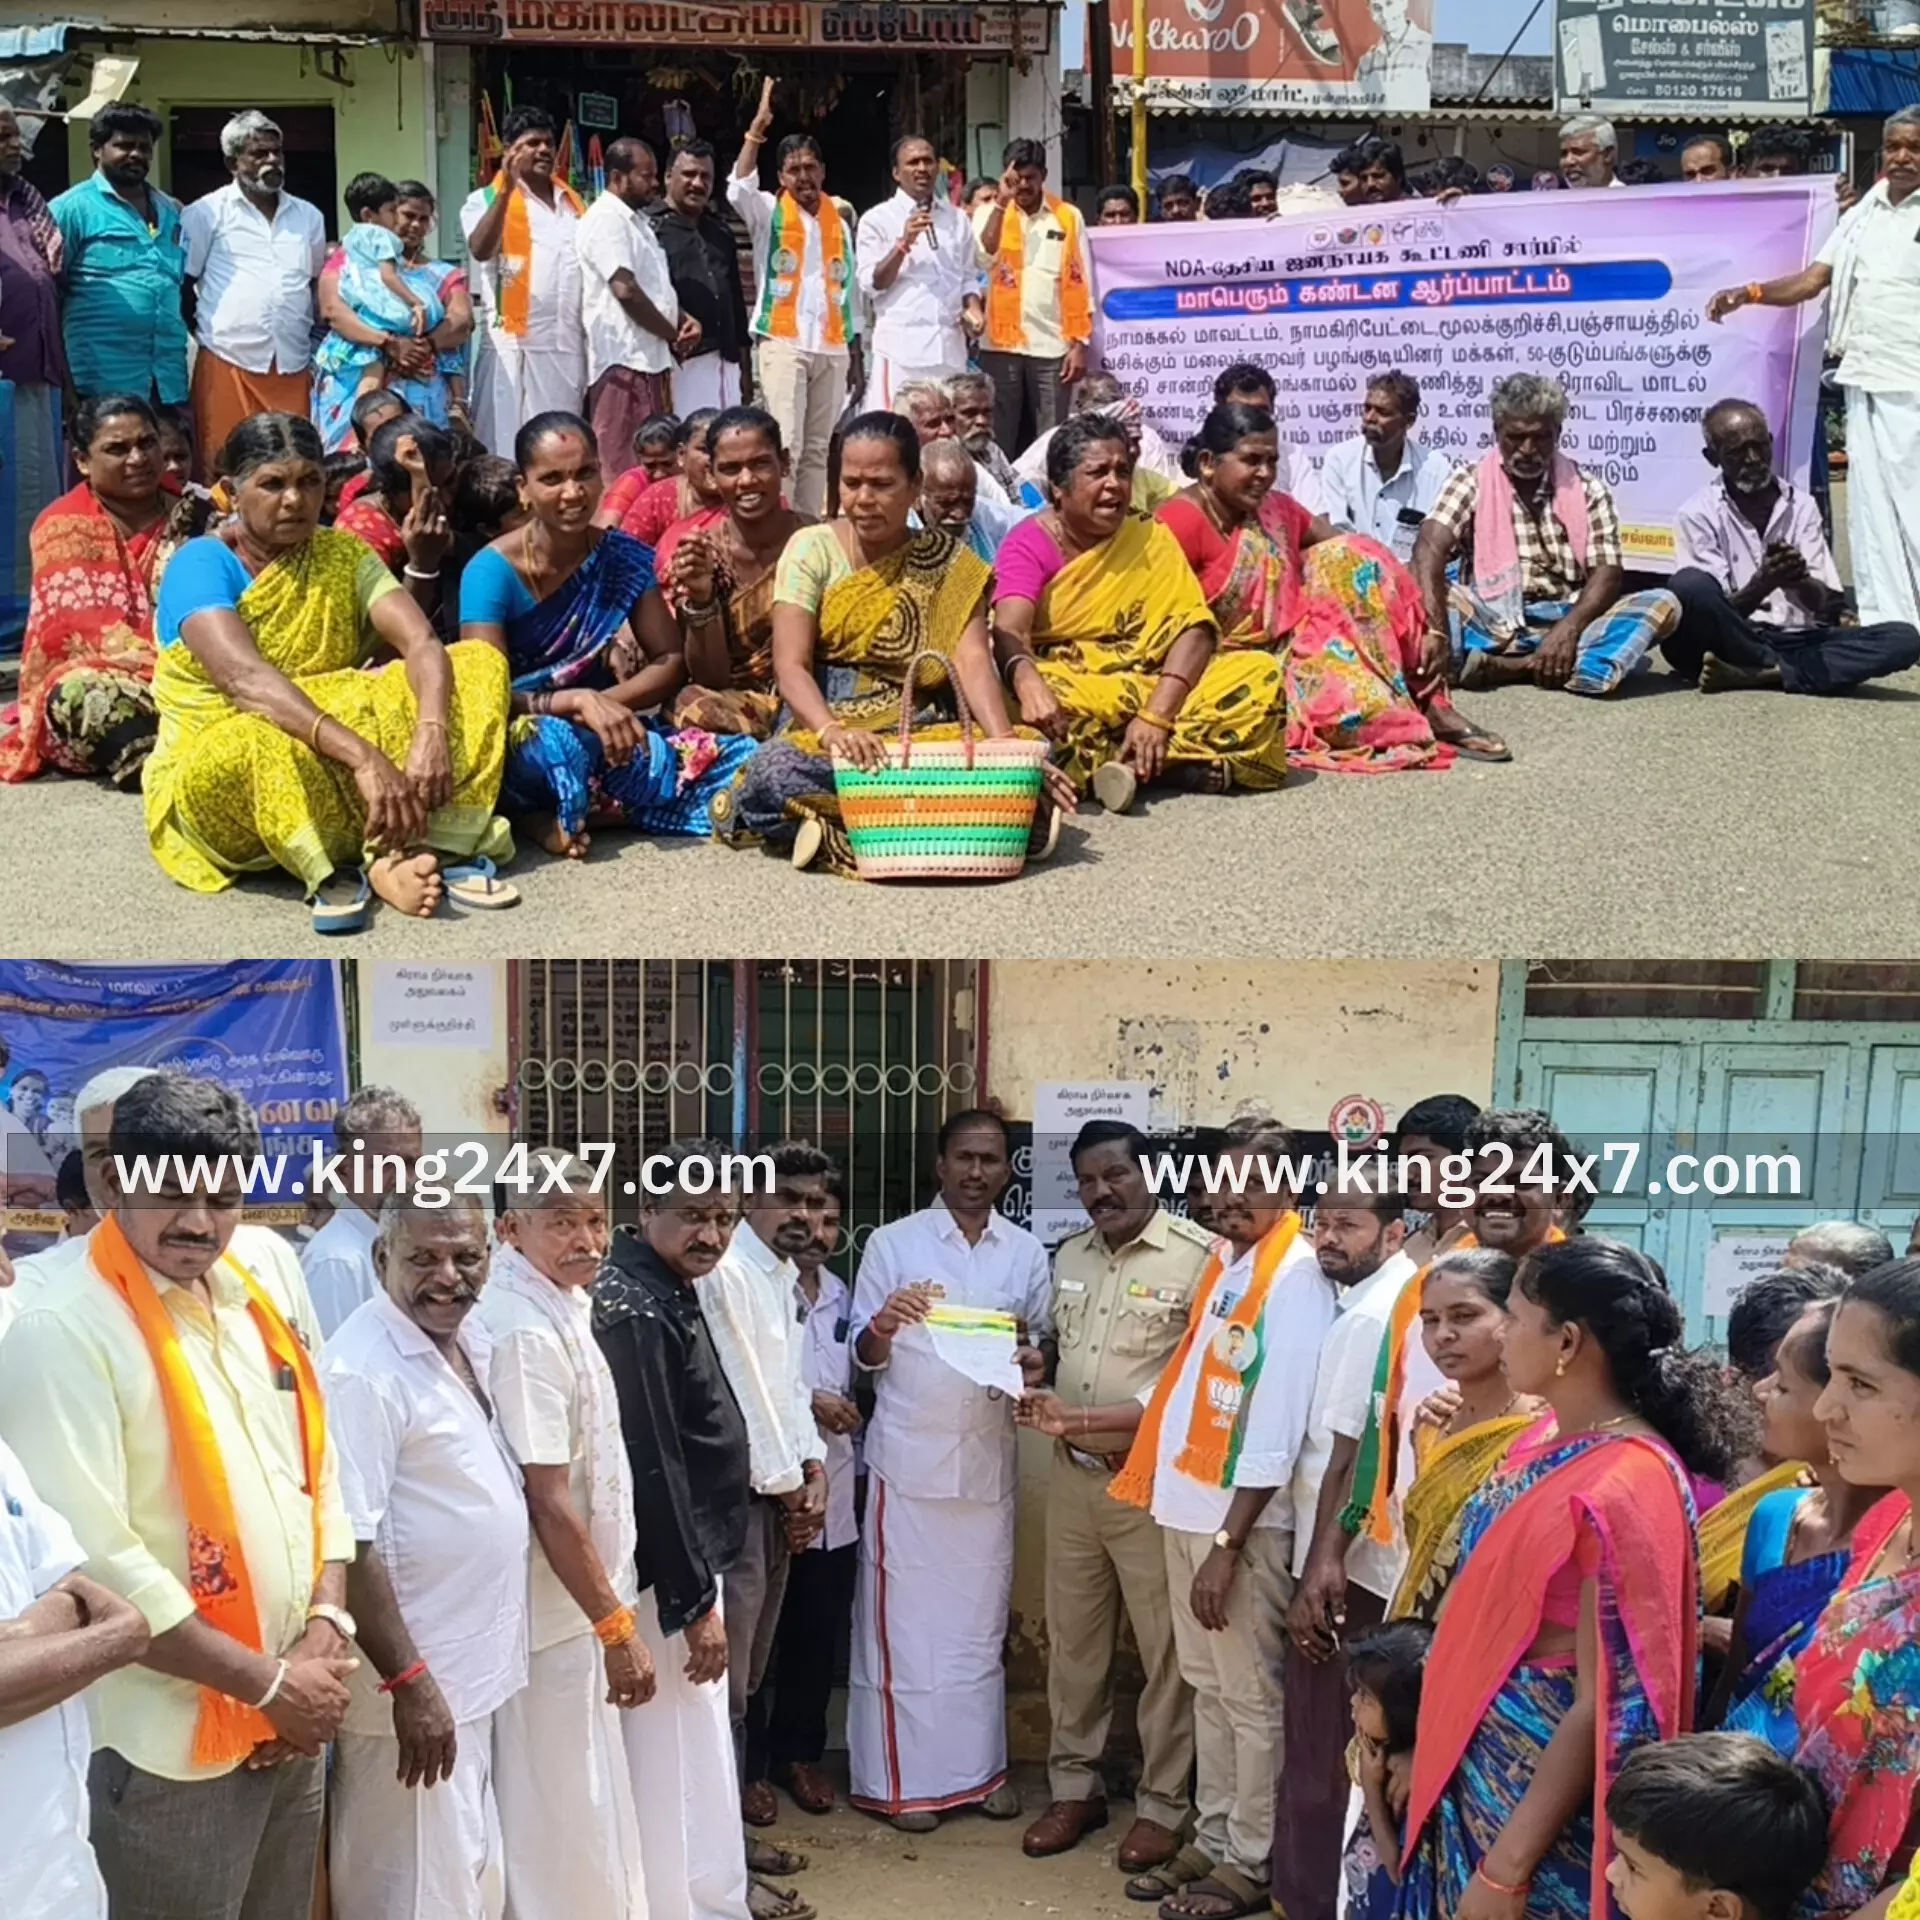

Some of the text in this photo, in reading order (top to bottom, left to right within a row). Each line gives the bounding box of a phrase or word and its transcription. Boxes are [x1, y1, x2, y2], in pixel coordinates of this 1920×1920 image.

[1612, 10, 1760, 37] மொபைல்ஸ்
[1176, 267, 1572, 312] மாபெரும் கண்டன ஆர்ப்பாட்டம்
[1106, 326, 1187, 350] நாமக்கல்
[1101, 350, 1177, 374] வசிக்கும்
[1313, 341, 1443, 372] பழங்குடியினர்
[1642, 370, 1708, 393] மாடல்
[1588, 430, 1657, 460] மற்றும்
